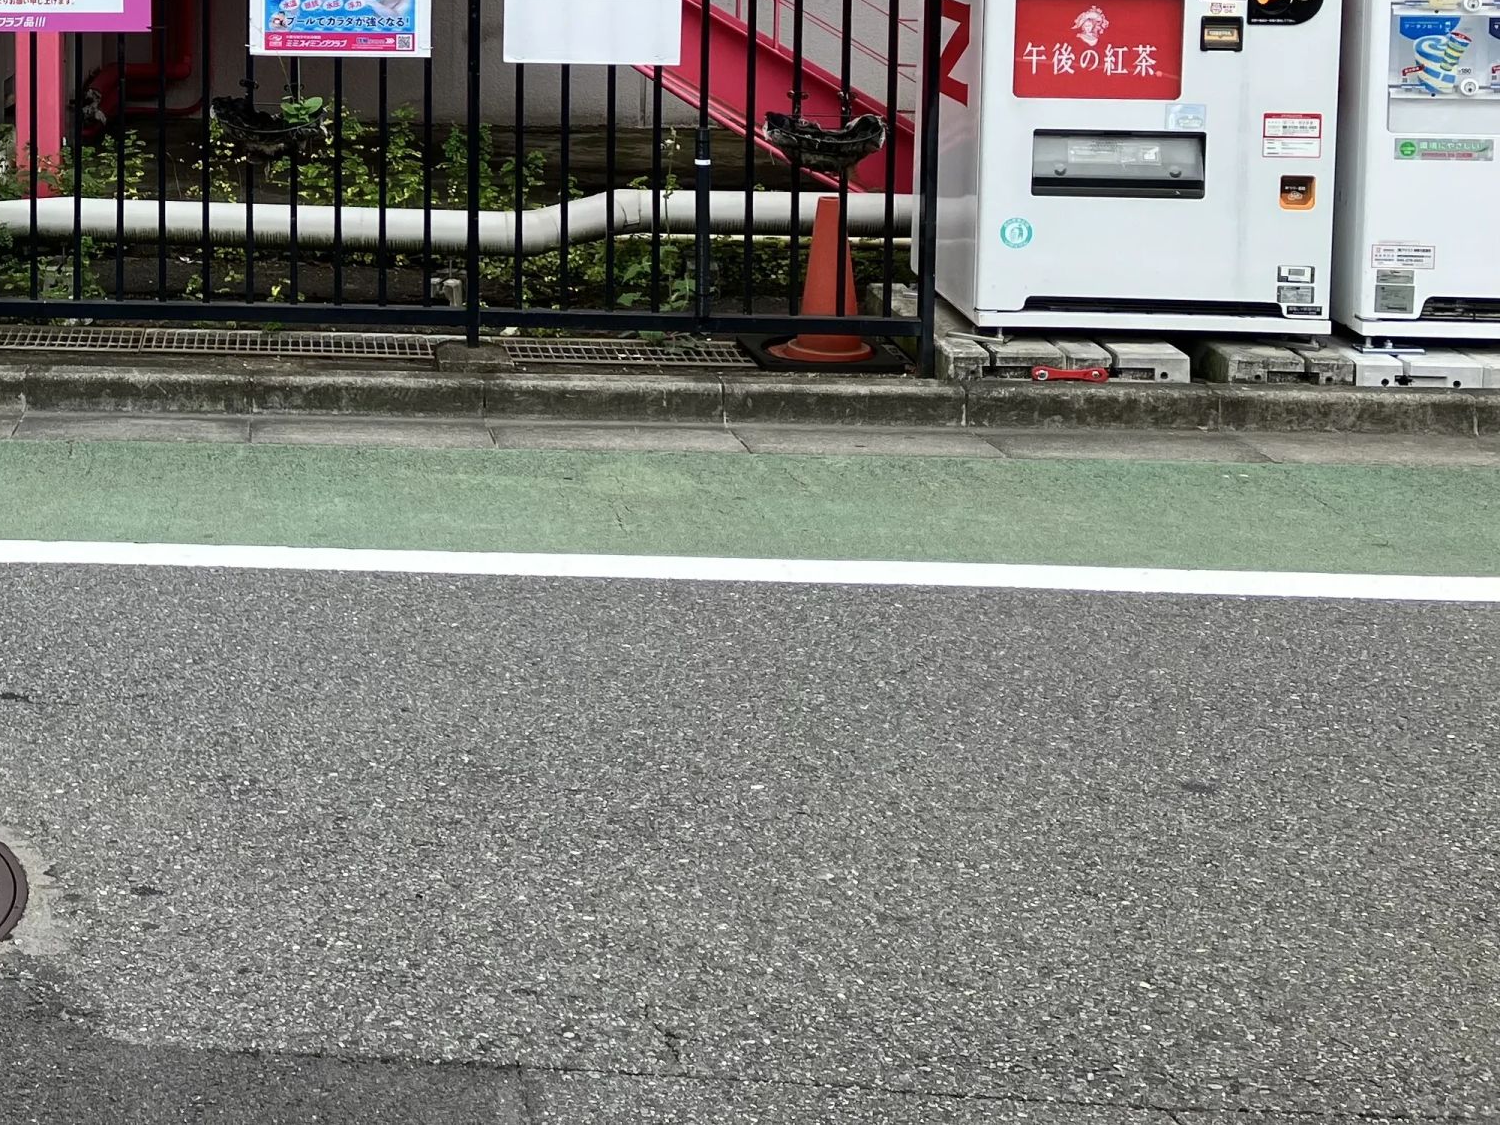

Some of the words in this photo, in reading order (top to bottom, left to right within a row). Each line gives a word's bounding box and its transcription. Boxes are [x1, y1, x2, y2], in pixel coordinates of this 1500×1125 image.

[1022, 41, 1157, 77] 午後の紅茶
